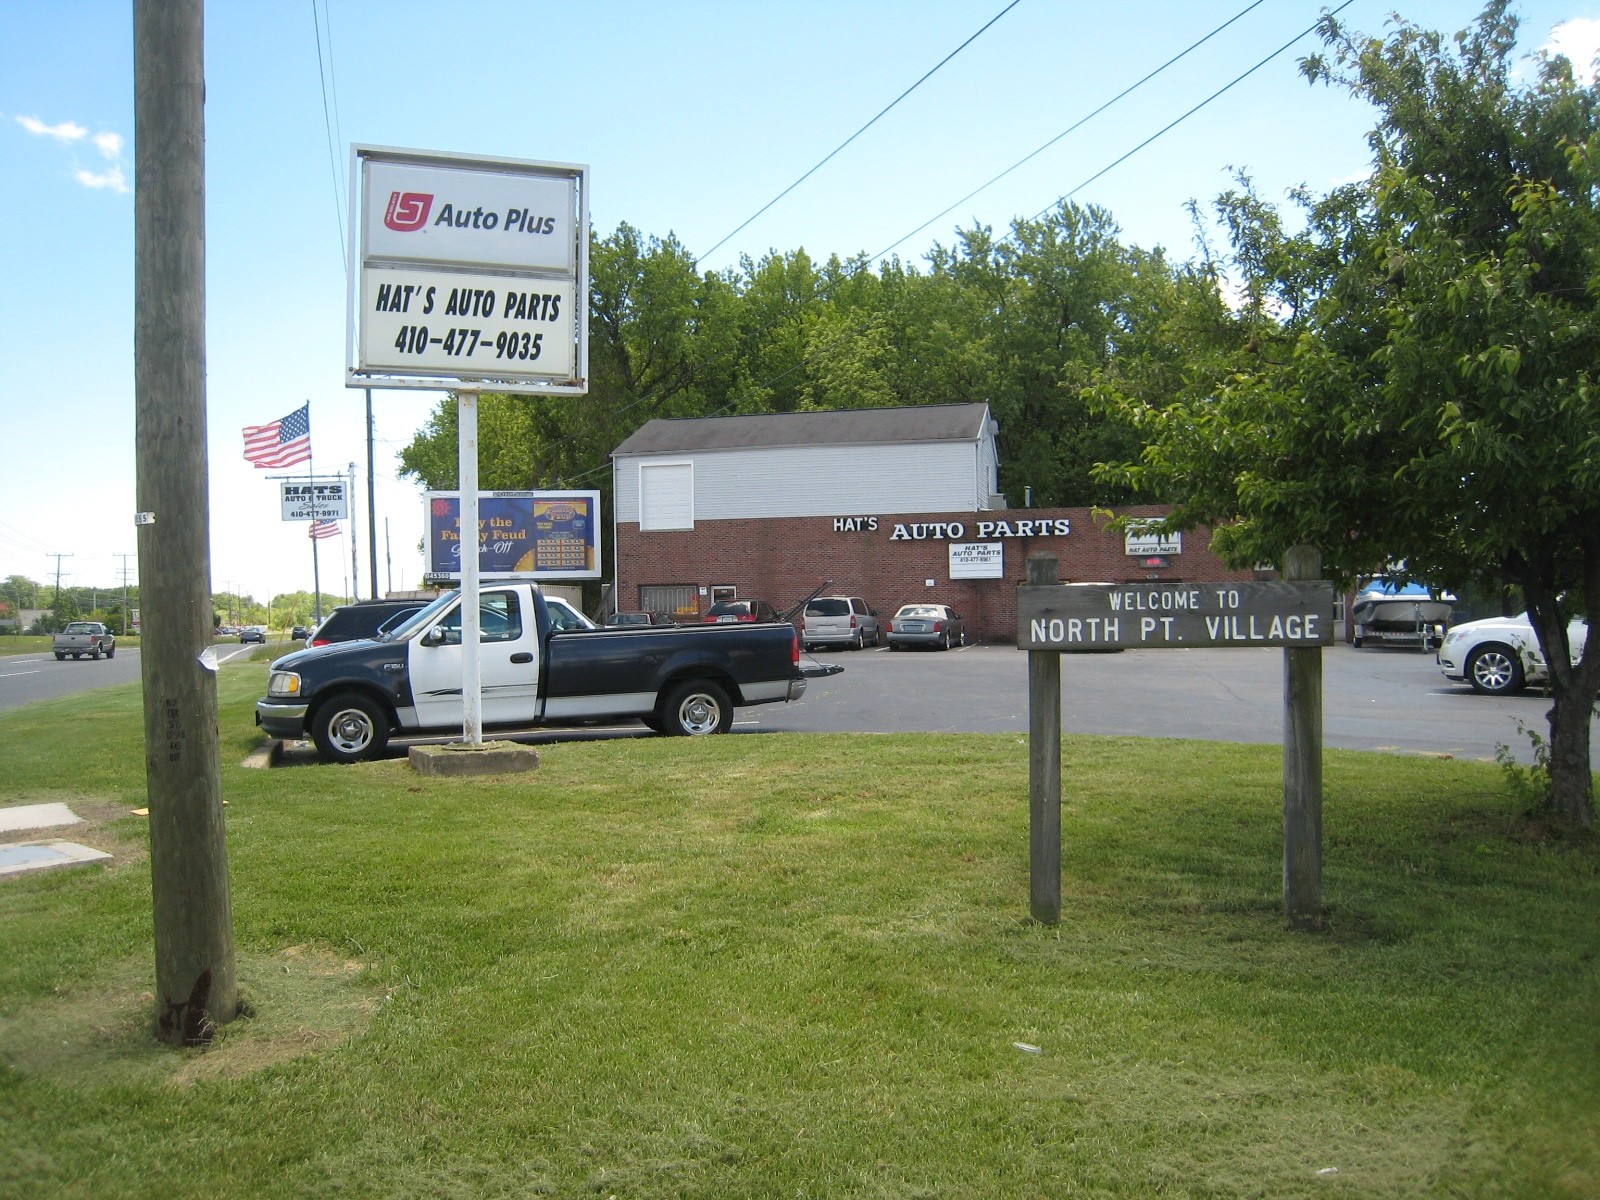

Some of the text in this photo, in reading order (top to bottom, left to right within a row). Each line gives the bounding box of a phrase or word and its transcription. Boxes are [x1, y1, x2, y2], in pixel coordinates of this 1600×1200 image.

[434, 203, 555, 235] Auto Plus
[375, 283, 561, 322] HAT'S AUTO PARTS
[394, 325, 543, 361] 410-477-9035
[490, 517, 513, 528] the
[492, 529, 527, 540] Feud
[833, 517, 1071, 540] HAT'S AUTO PARTS
[1109, 590, 1239, 611] WELCOME TO
[1030, 614, 1320, 643] NORTH PT. VILLAGE
